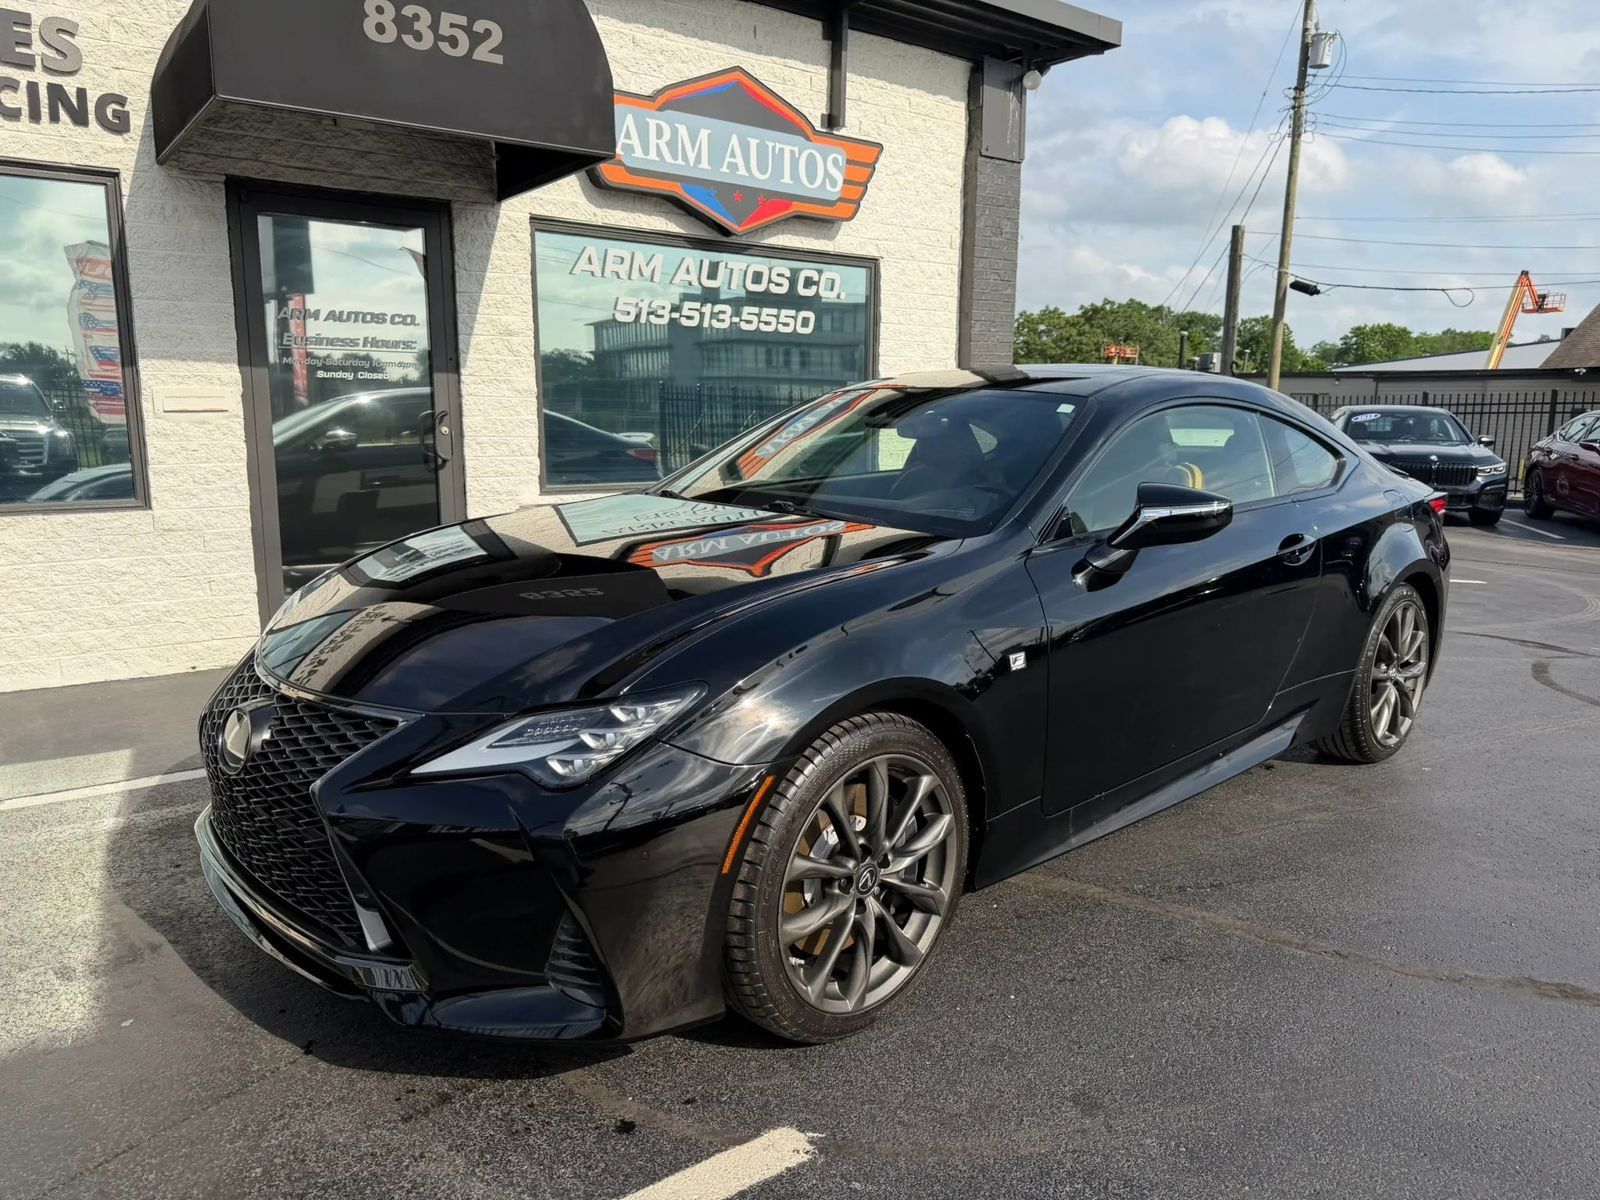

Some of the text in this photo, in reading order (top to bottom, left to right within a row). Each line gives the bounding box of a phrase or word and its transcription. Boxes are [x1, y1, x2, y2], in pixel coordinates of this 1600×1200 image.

[363, 0, 504, 65] 8352
[615, 113, 844, 193] ARM AUTOS
[569, 245, 847, 300] ARM AUTOS CO.
[277, 306, 420, 327] ARM AUTOS CO.
[612, 297, 816, 335] 513-513-5550
[282, 332, 361, 348] Business
[316, 370, 354, 380] Sunday
